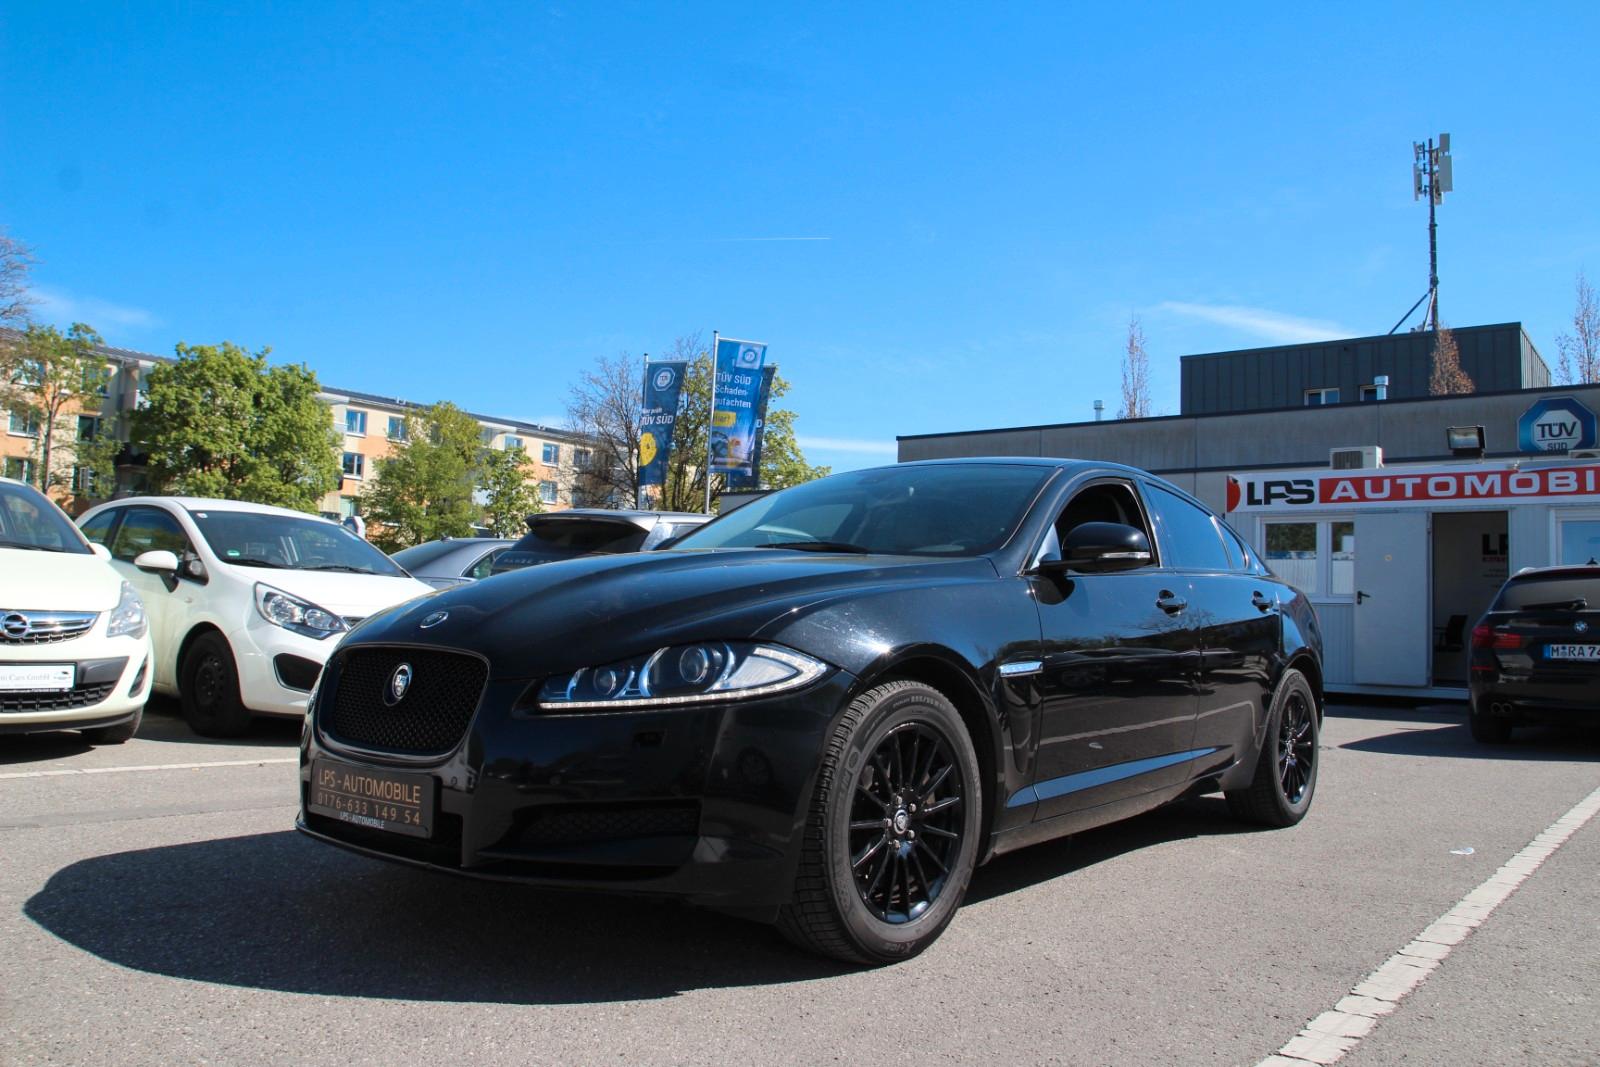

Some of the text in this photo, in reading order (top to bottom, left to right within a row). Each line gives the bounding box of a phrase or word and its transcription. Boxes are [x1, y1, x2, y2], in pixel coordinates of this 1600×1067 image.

[734, 372, 752, 385] SÜD
[655, 413, 674, 425] SÜD
[1536, 421, 1577, 438] TÜV
[1246, 470, 1595, 506] LPS AUTOMOBI
[1551, 646, 1560, 656] M
[1568, 646, 1585, 657] RA
